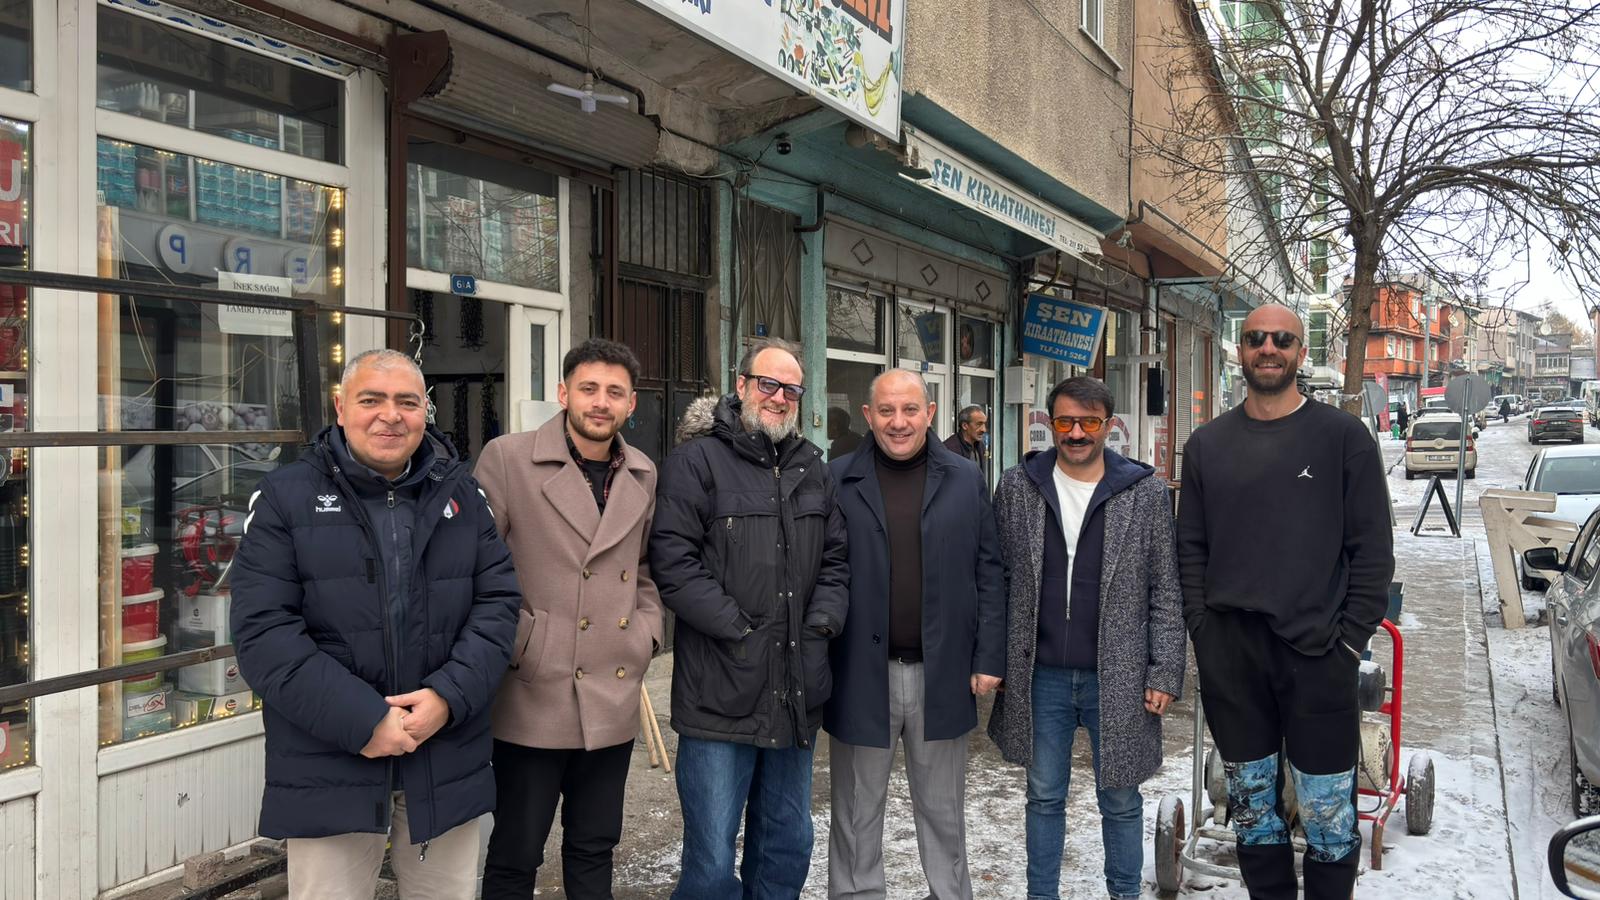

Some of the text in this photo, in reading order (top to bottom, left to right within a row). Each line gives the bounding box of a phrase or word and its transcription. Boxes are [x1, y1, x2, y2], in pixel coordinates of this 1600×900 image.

[932, 158, 1056, 238] ŞEN KIRAATHANESİ
[1036, 302, 1092, 328] ŞEN
[1024, 322, 1095, 351] KIRAATHANESİ
[315, 505, 342, 513] hummel
